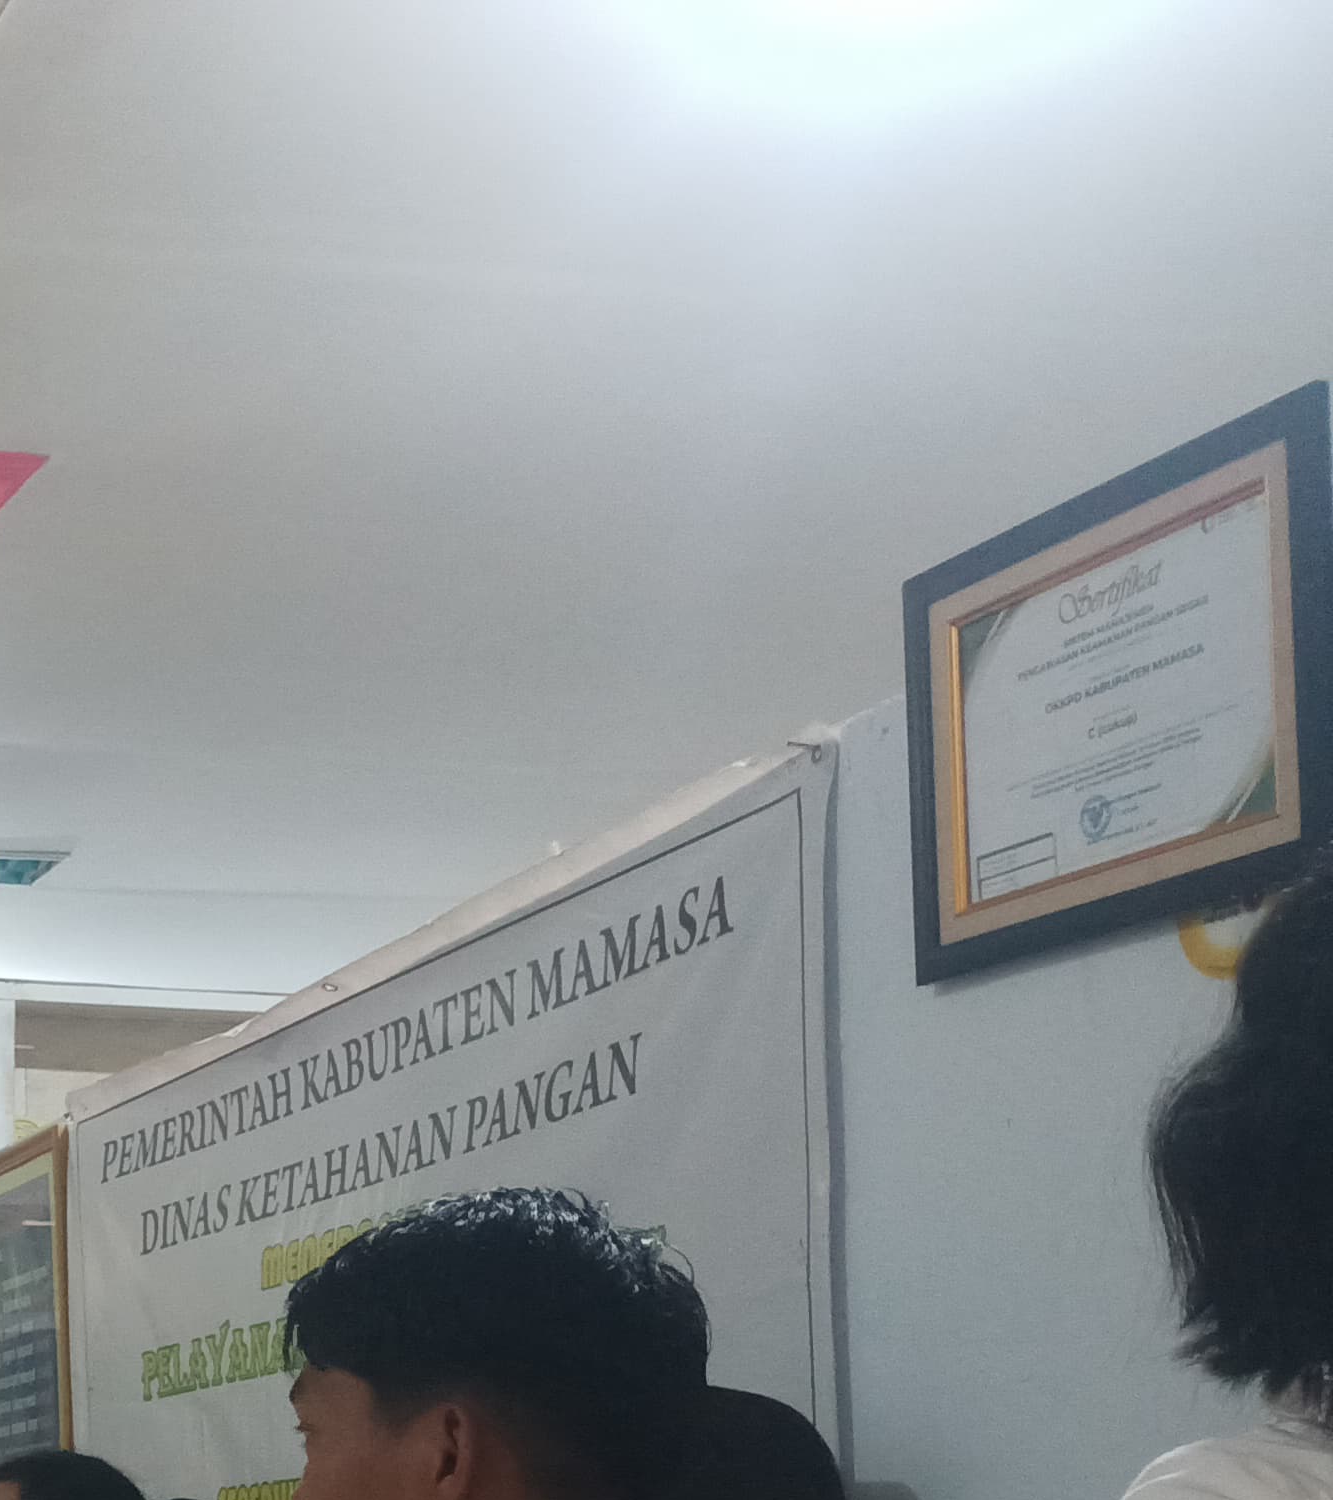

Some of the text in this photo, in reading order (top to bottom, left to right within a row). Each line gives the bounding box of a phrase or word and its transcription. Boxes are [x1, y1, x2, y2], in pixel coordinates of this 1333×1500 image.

[101, 876, 733, 1183] PEMERINTAH KABUPATEN MAMASA
[141, 1033, 642, 1256] DINAS KETAHANAN PANGAN
